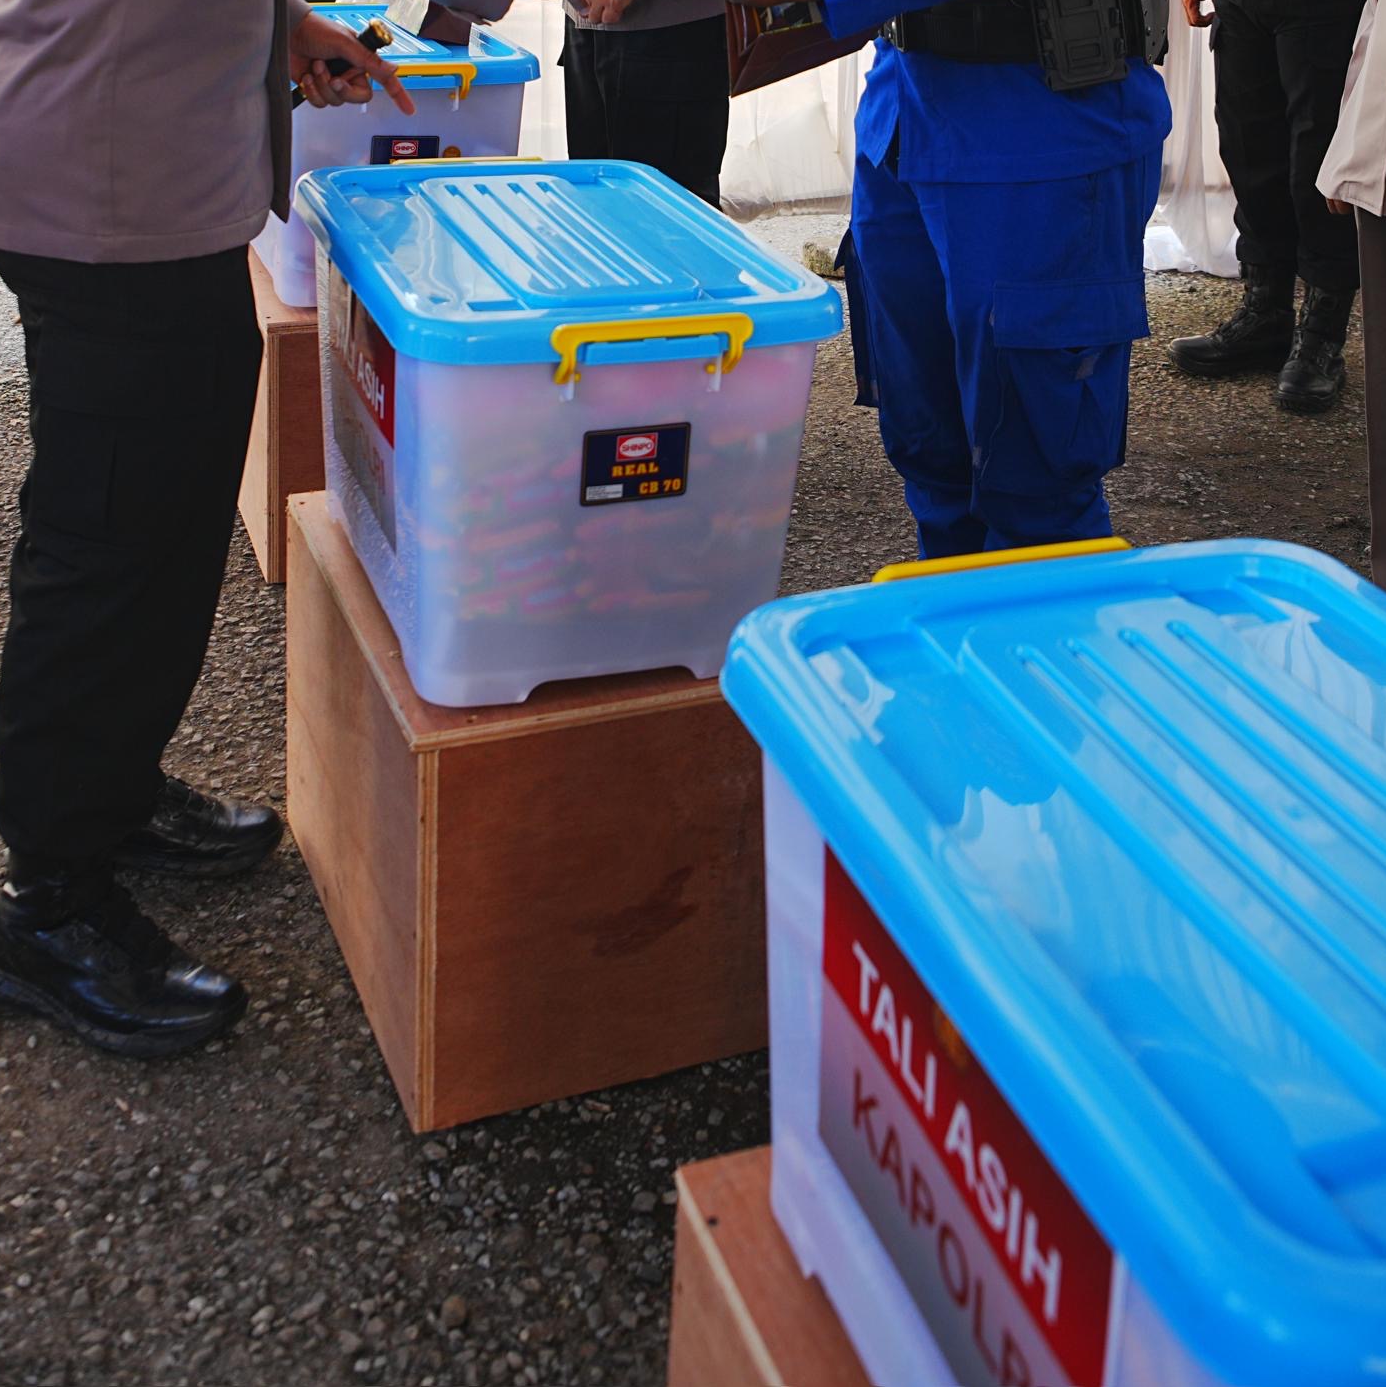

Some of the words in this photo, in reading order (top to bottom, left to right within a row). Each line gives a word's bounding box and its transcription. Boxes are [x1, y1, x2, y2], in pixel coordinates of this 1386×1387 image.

[357, 351, 385, 420] ASIH
[611, 462, 659, 477] REAL
[639, 481, 659, 494] CB
[663, 478, 681, 492] 70
[852, 940, 938, 1120] TALI
[944, 1100, 1062, 1325] ASIH
